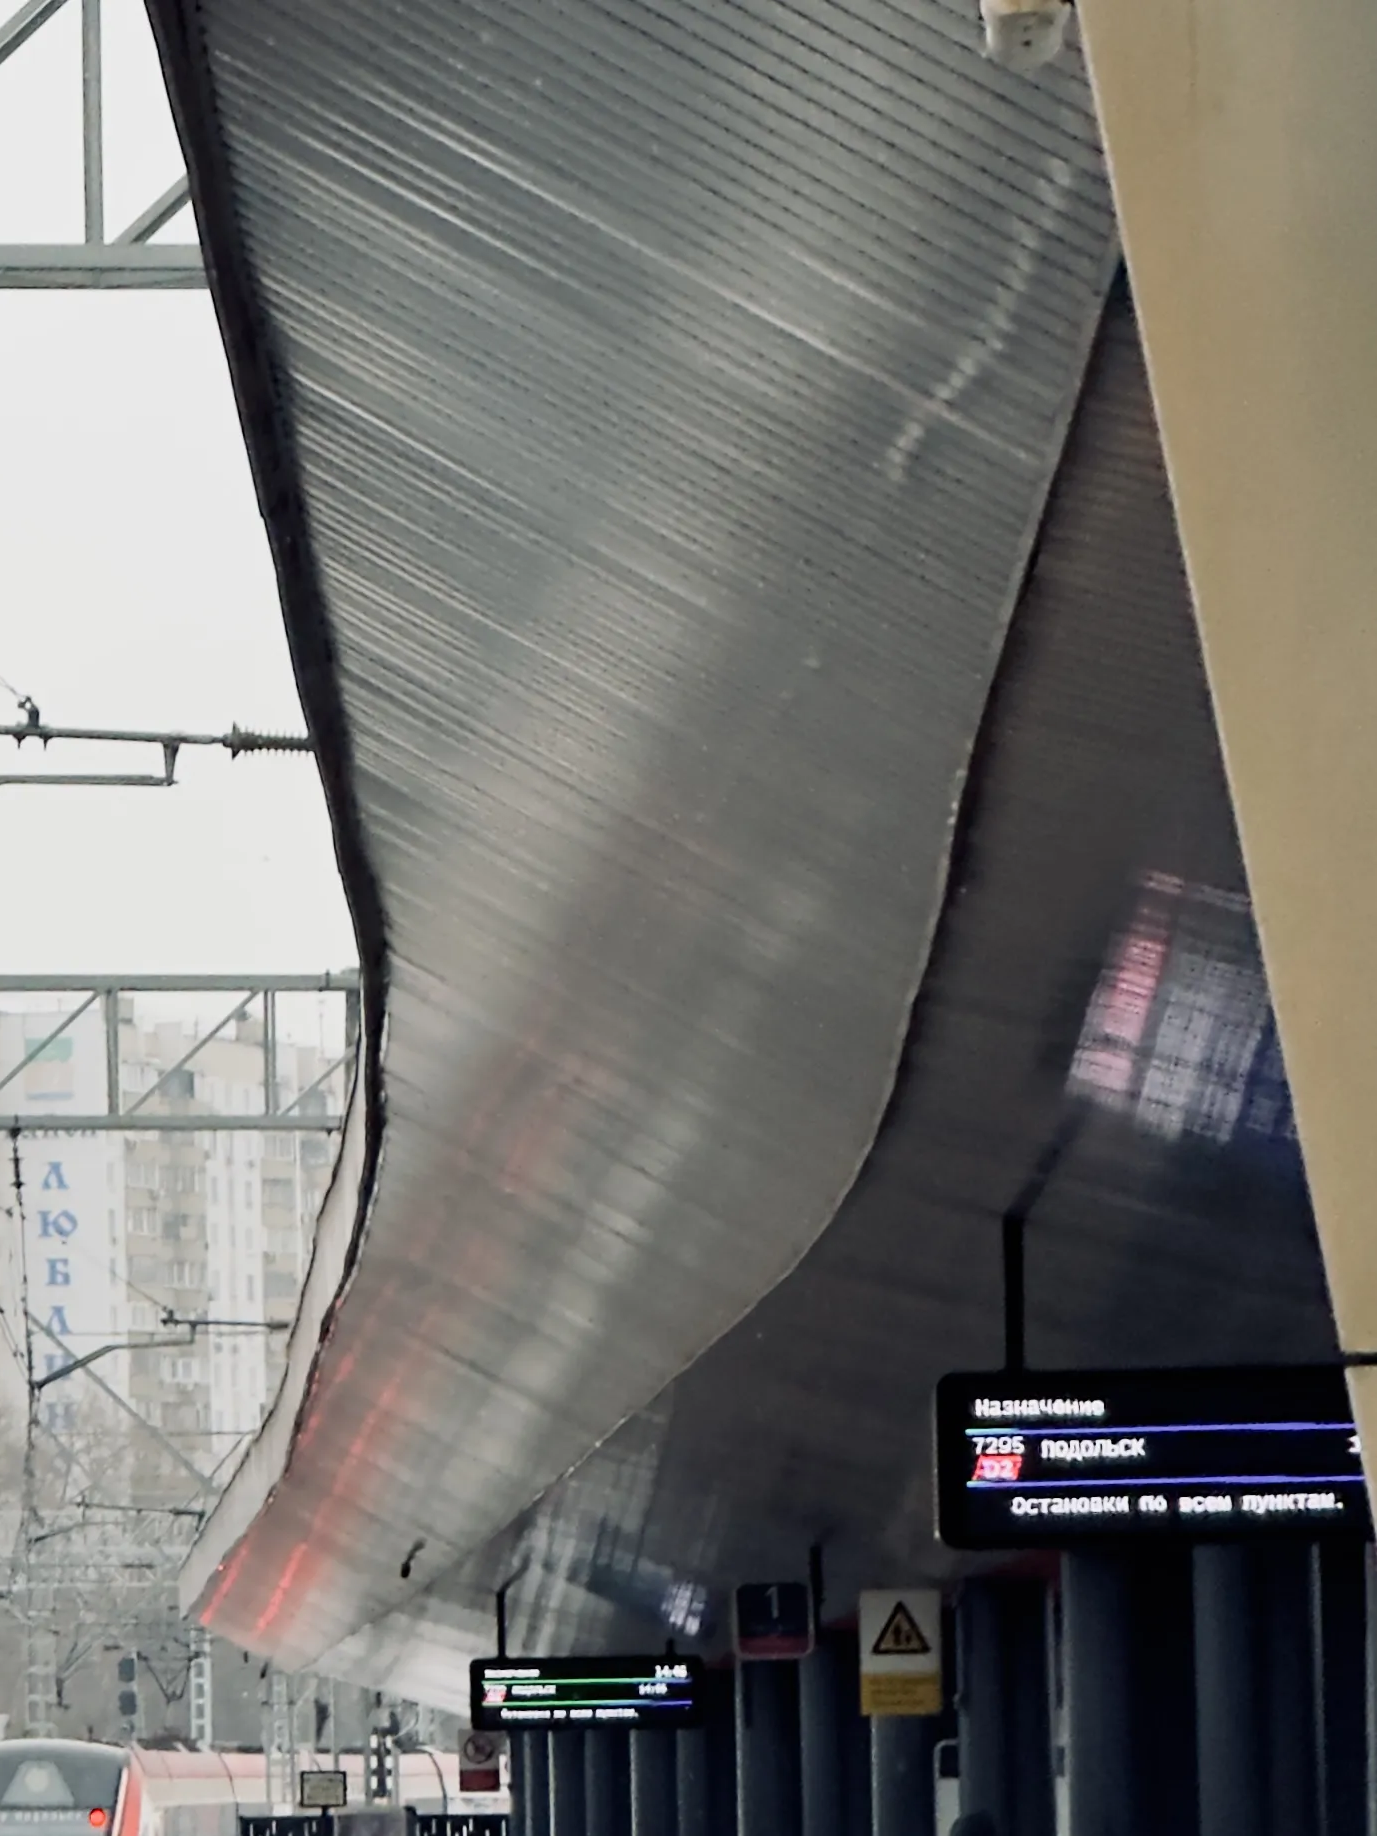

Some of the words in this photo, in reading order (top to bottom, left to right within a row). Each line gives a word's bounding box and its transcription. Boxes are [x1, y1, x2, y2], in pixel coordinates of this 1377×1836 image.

[974, 1398, 1105, 1417] Назначение
[971, 1436, 1025, 1455] 7295
[1040, 1438, 1146, 1461] ПОДОЛЬСК
[1010, 1495, 1129, 1515] Остановки
[1139, 1494, 1168, 1513] по
[1178, 1494, 1232, 1513] всем
[1241, 1491, 1344, 1514] пунктам.
[763, 1584, 781, 1620] 1
